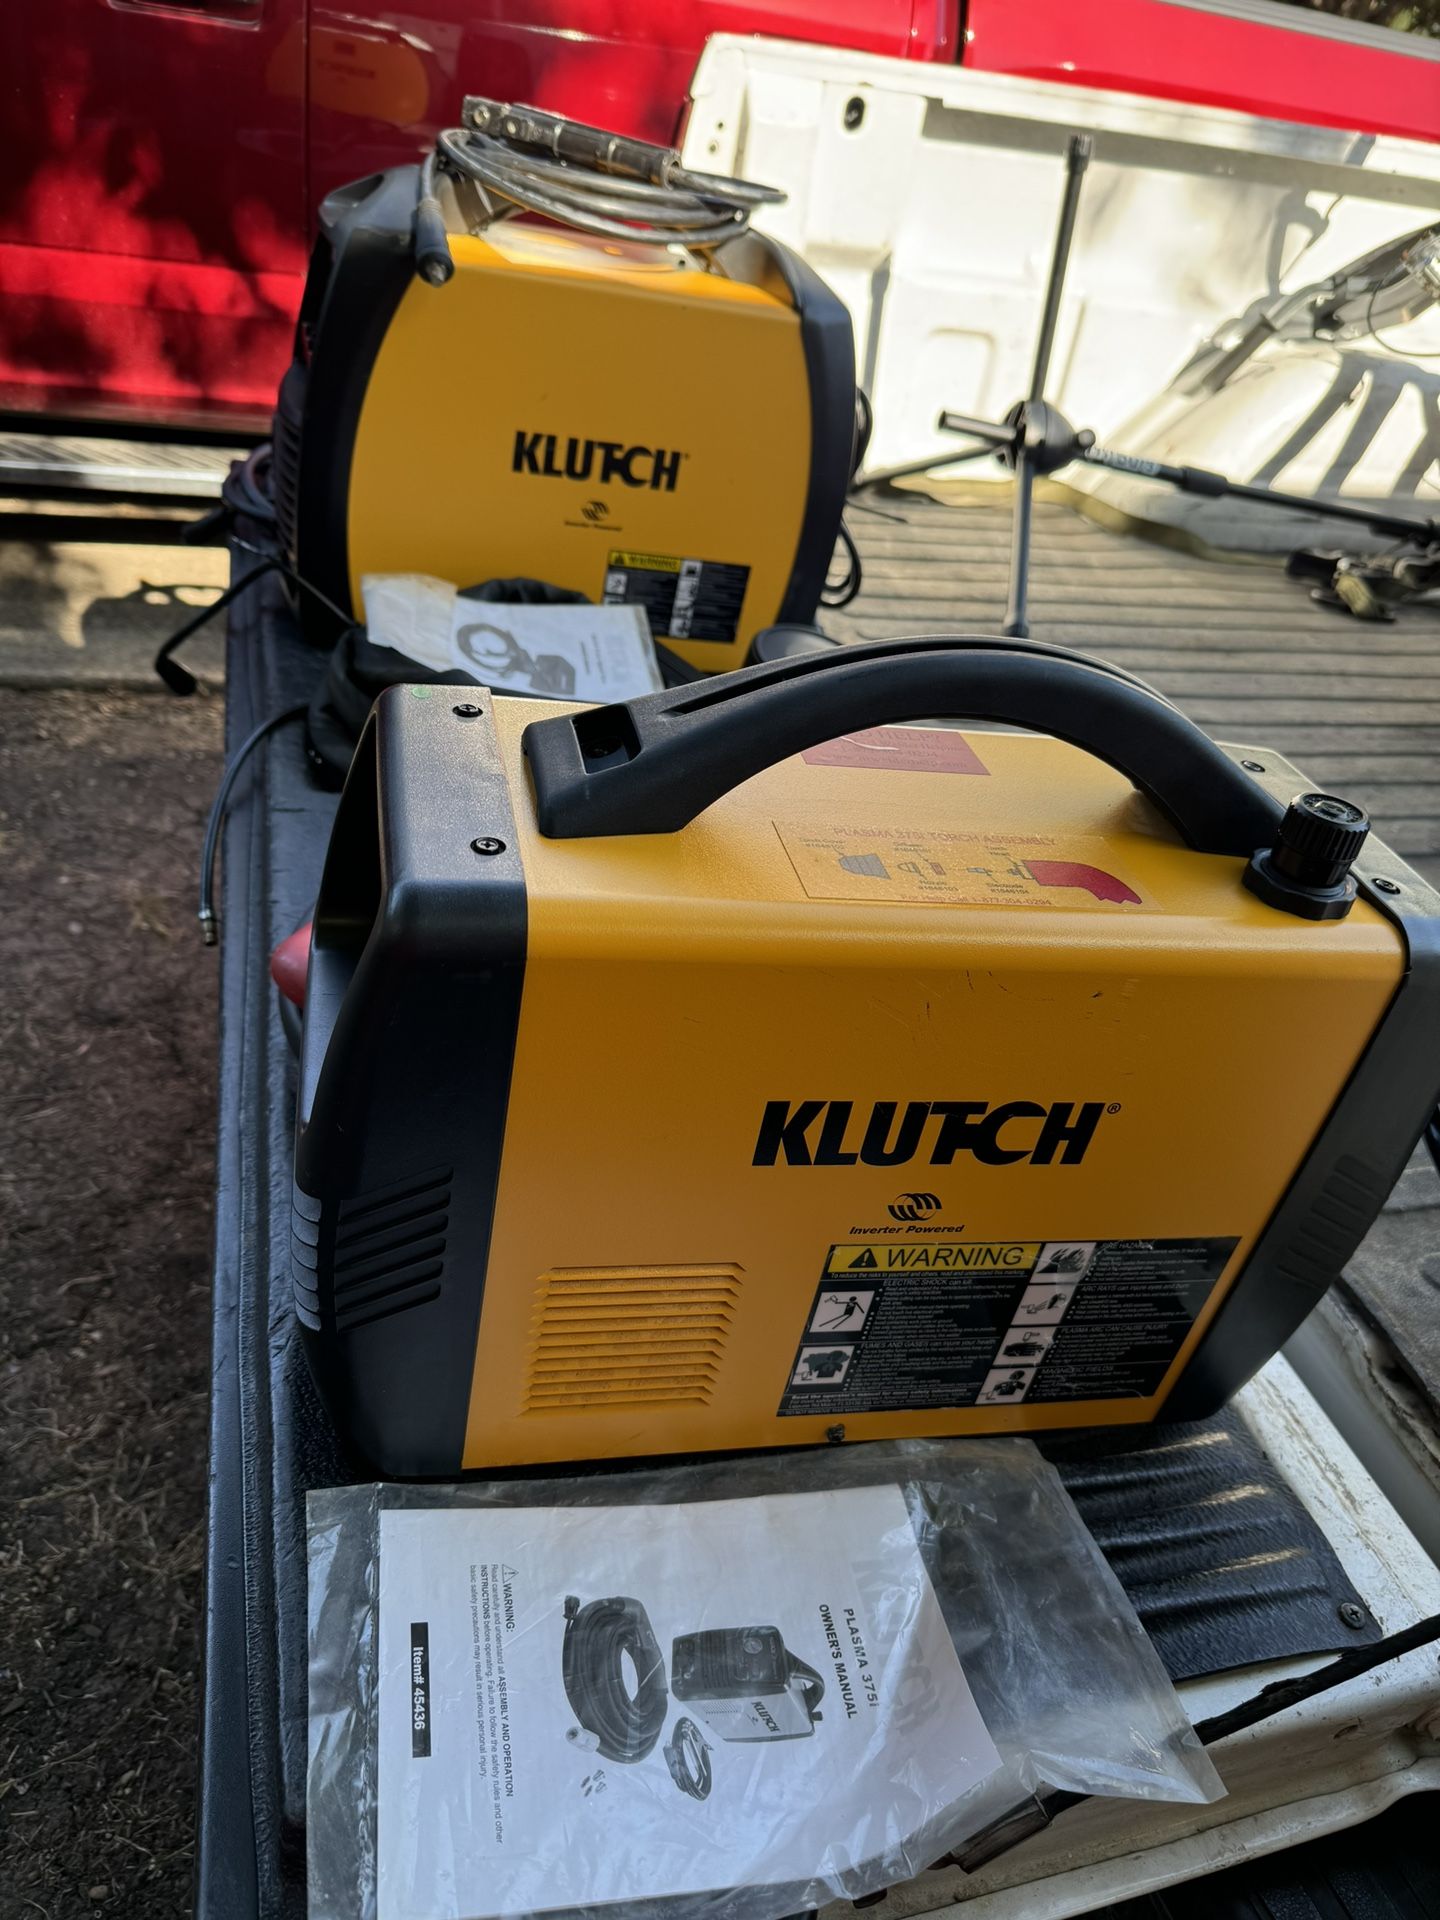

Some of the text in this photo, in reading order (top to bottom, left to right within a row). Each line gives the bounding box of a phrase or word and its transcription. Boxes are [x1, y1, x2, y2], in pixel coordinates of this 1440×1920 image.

[512, 430, 682, 492] KLUTCH
[834, 827, 893, 839] PLASMA
[930, 830, 978, 842] TORCH
[983, 834, 1056, 846] ASSEMBLY
[849, 1224, 965, 1236] Inverter Powered
[887, 1247, 1024, 1268] WARNING
[883, 1279, 919, 1287] ELECTRIC
[470, 1564, 478, 1583] basic
[491, 1564, 499, 1583] Read
[469, 1584, 479, 1604] safety
[491, 1583, 502, 1611] carefully
[503, 1583, 515, 1633] WARNING:
[469, 1605, 481, 1644] precautions
[494, 1612, 502, 1625] and
[473, 1645, 481, 1659] may
[495, 1626, 504, 1664] understand
[843, 1608, 879, 1707] PLASMA 375i
[474, 1661, 483, 1681] result
[819, 1604, 858, 1719] OWNER'S MANUAL
[413, 1646, 425, 1730] Item# 45436
[497, 1676, 509, 1721] ASSEMBLY
[476, 1691, 485, 1719] serious
[480, 1564, 504, 1844] INSTRUCTIONS before operating. Failure to follow the safety rules and other
[751, 1701, 780, 1732] KLUTCH
[476, 1720, 487, 1753] personal
[501, 1723, 510, 1742] AND
[478, 1755, 488, 1780] injury.
[503, 1743, 514, 1797] OPERATION
